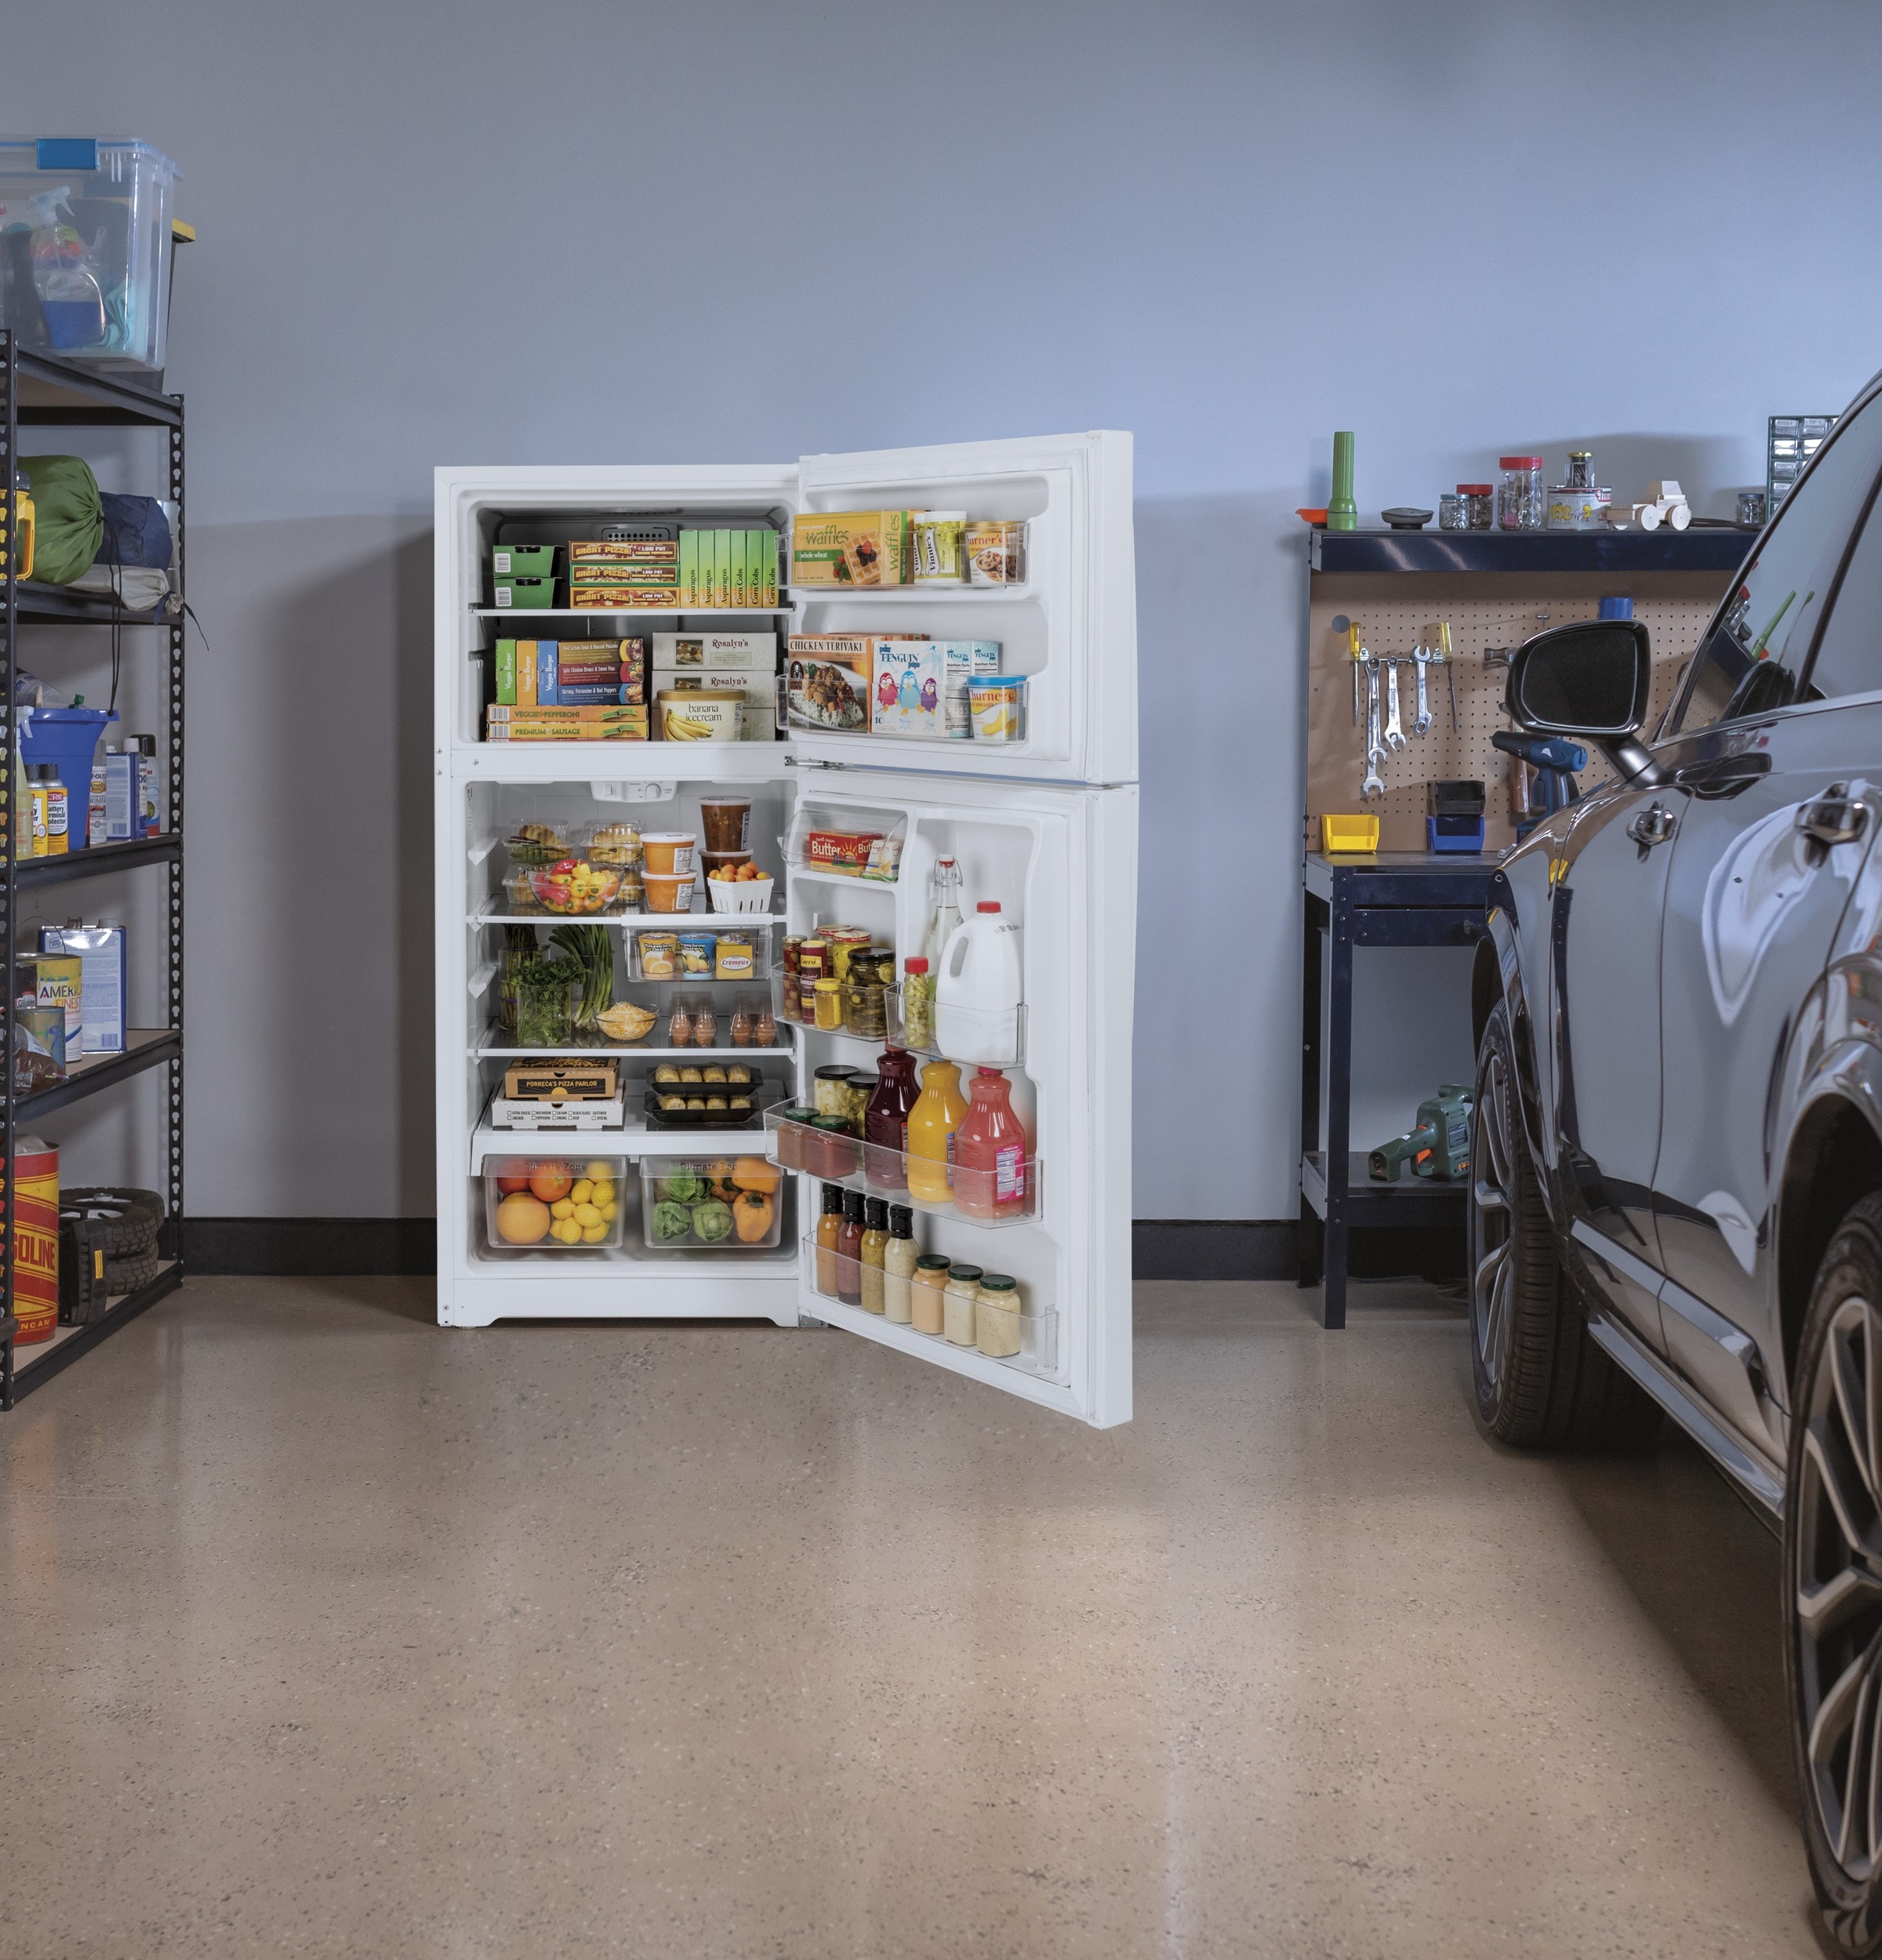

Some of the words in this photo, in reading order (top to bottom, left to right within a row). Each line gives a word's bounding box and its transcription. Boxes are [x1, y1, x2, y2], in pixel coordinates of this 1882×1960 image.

[806, 524, 849, 545] waffles
[885, 514, 899, 571] waffles
[576, 546, 602, 555] GREAT
[605, 546, 632, 555] PIZZA!
[576, 569, 601, 578] GREAT
[603, 569, 629, 578] PIZZA!
[689, 569, 698, 605] Asparagus
[576, 593, 601, 602] GREAT
[603, 593, 630, 602] PIZZA!
[712, 639, 749, 648] Rosalyn's
[790, 641, 823, 650] CHICKEN
[826, 641, 863, 652] TERIYAKI
[545, 654, 554, 672] Burger
[881, 653, 919, 662] PENGUIN
[523, 655, 532, 673] Burger
[504, 671, 513, 690] Veggie
[523, 674, 532, 692] Veggie
[545, 673, 554, 691] Veggie
[710, 677, 747, 687] Rosalyn's
[688, 703, 719, 713] banana
[812, 840, 841, 855] Butter
[523, 1162, 561, 1171] Climate
[563, 1162, 587, 1171] Zone
[680, 1162, 718, 1171] Climate
[720, 1162, 743, 1171] Zone
[13, 1232, 55, 1271] SOLINE
[20, 1319, 50, 1330] NCAN
